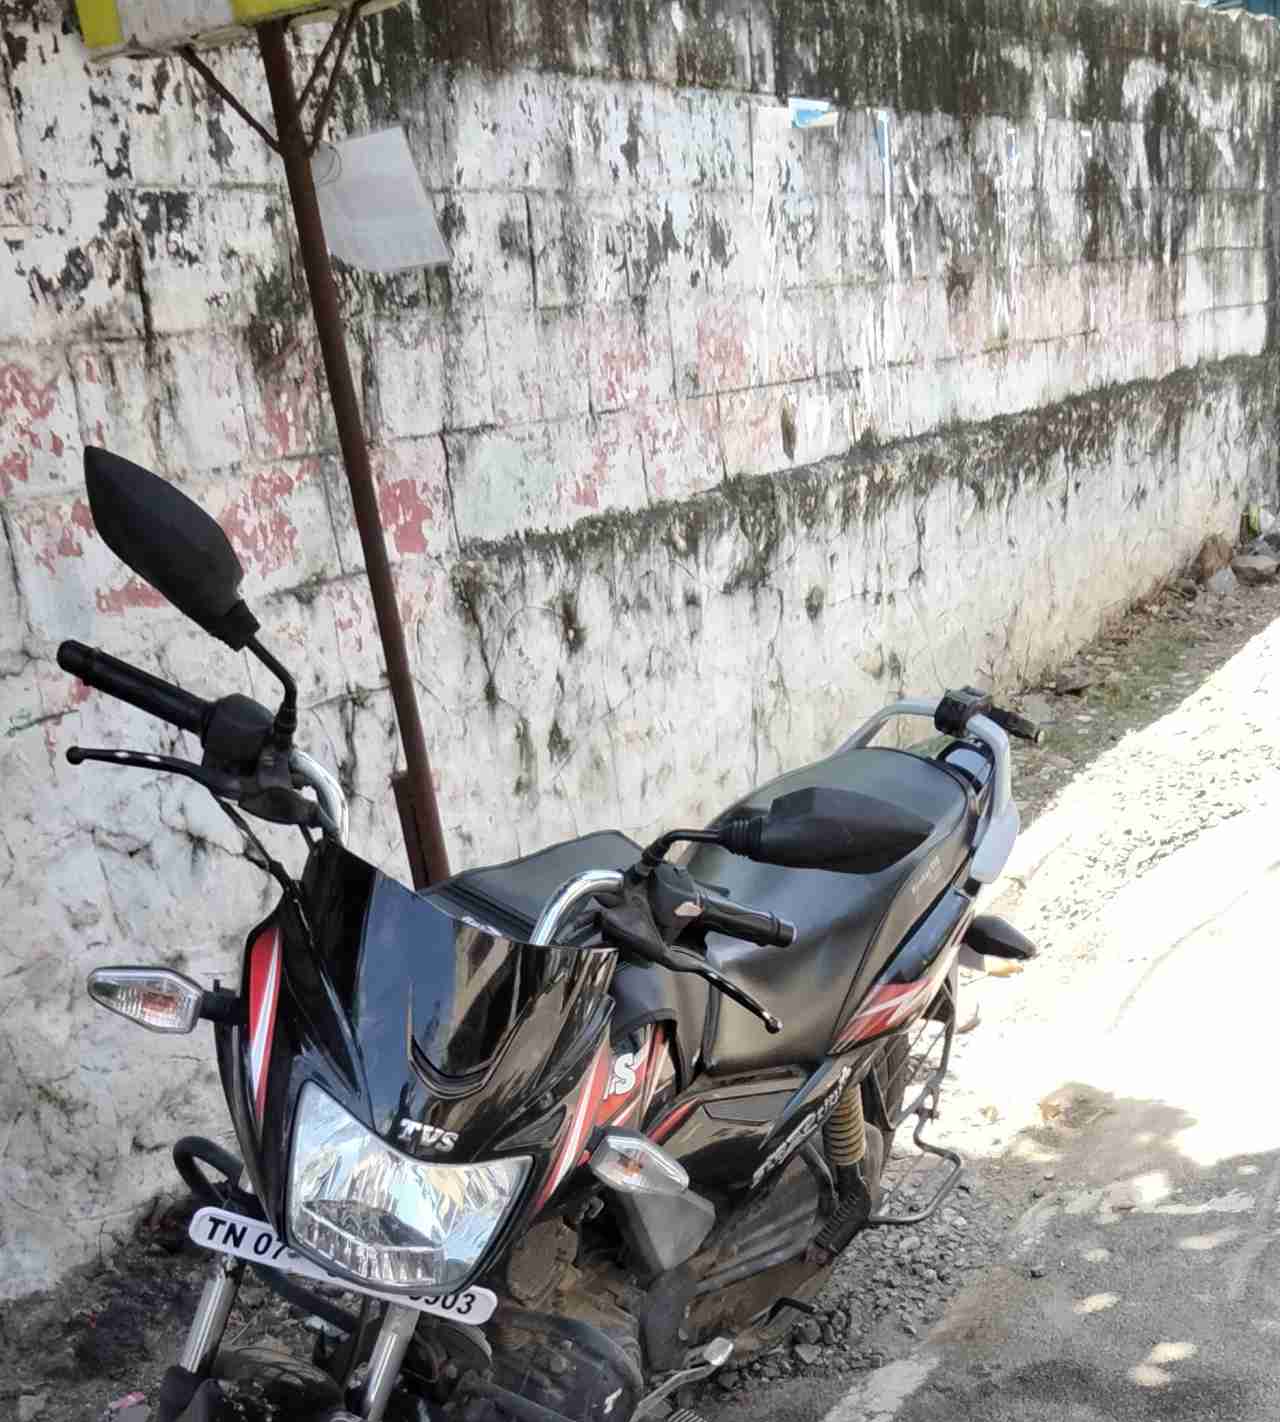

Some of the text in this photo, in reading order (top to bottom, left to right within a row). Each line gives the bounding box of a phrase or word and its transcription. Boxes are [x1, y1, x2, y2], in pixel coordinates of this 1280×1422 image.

[398, 1117, 459, 1152] TVS
[207, 1216, 248, 1249] TN
[408, 1292, 476, 1315] 03
